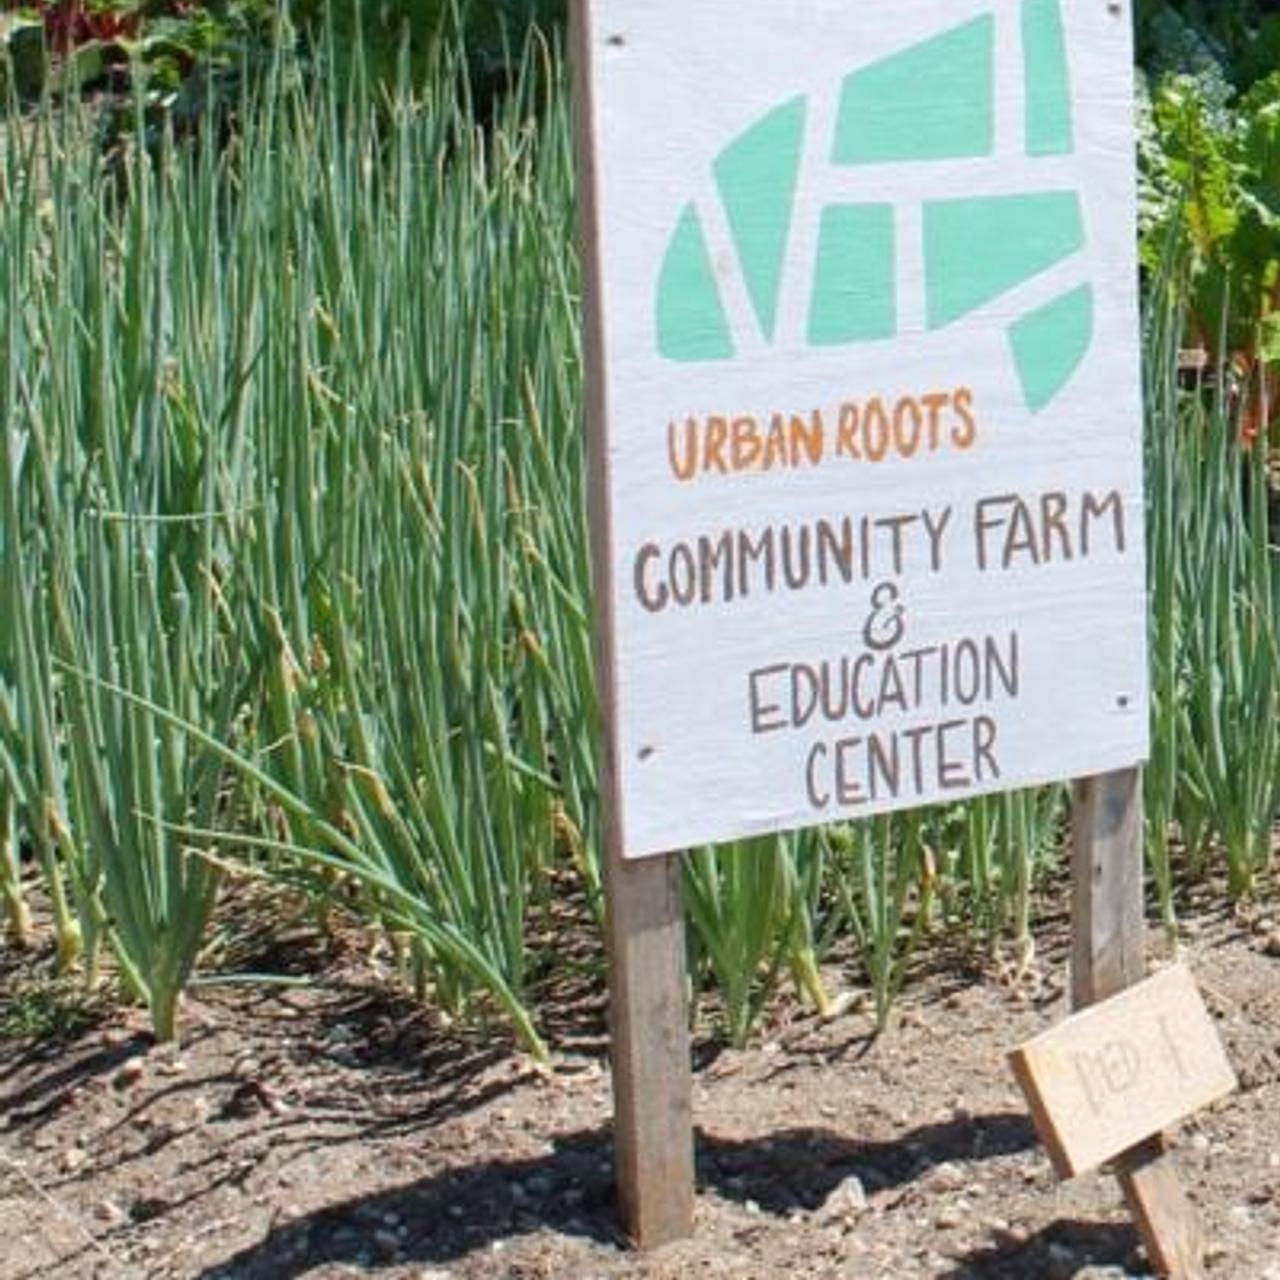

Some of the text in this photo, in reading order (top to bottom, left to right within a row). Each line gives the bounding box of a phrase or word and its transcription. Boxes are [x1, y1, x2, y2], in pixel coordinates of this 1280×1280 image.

[667, 387, 977, 481] URBAN ROOTS
[633, 489, 1127, 613] COMMUNITY FARM
[862, 581, 906, 651] &
[748, 631, 1020, 735] EDUCATION
[806, 717, 1001, 810] CENTER
